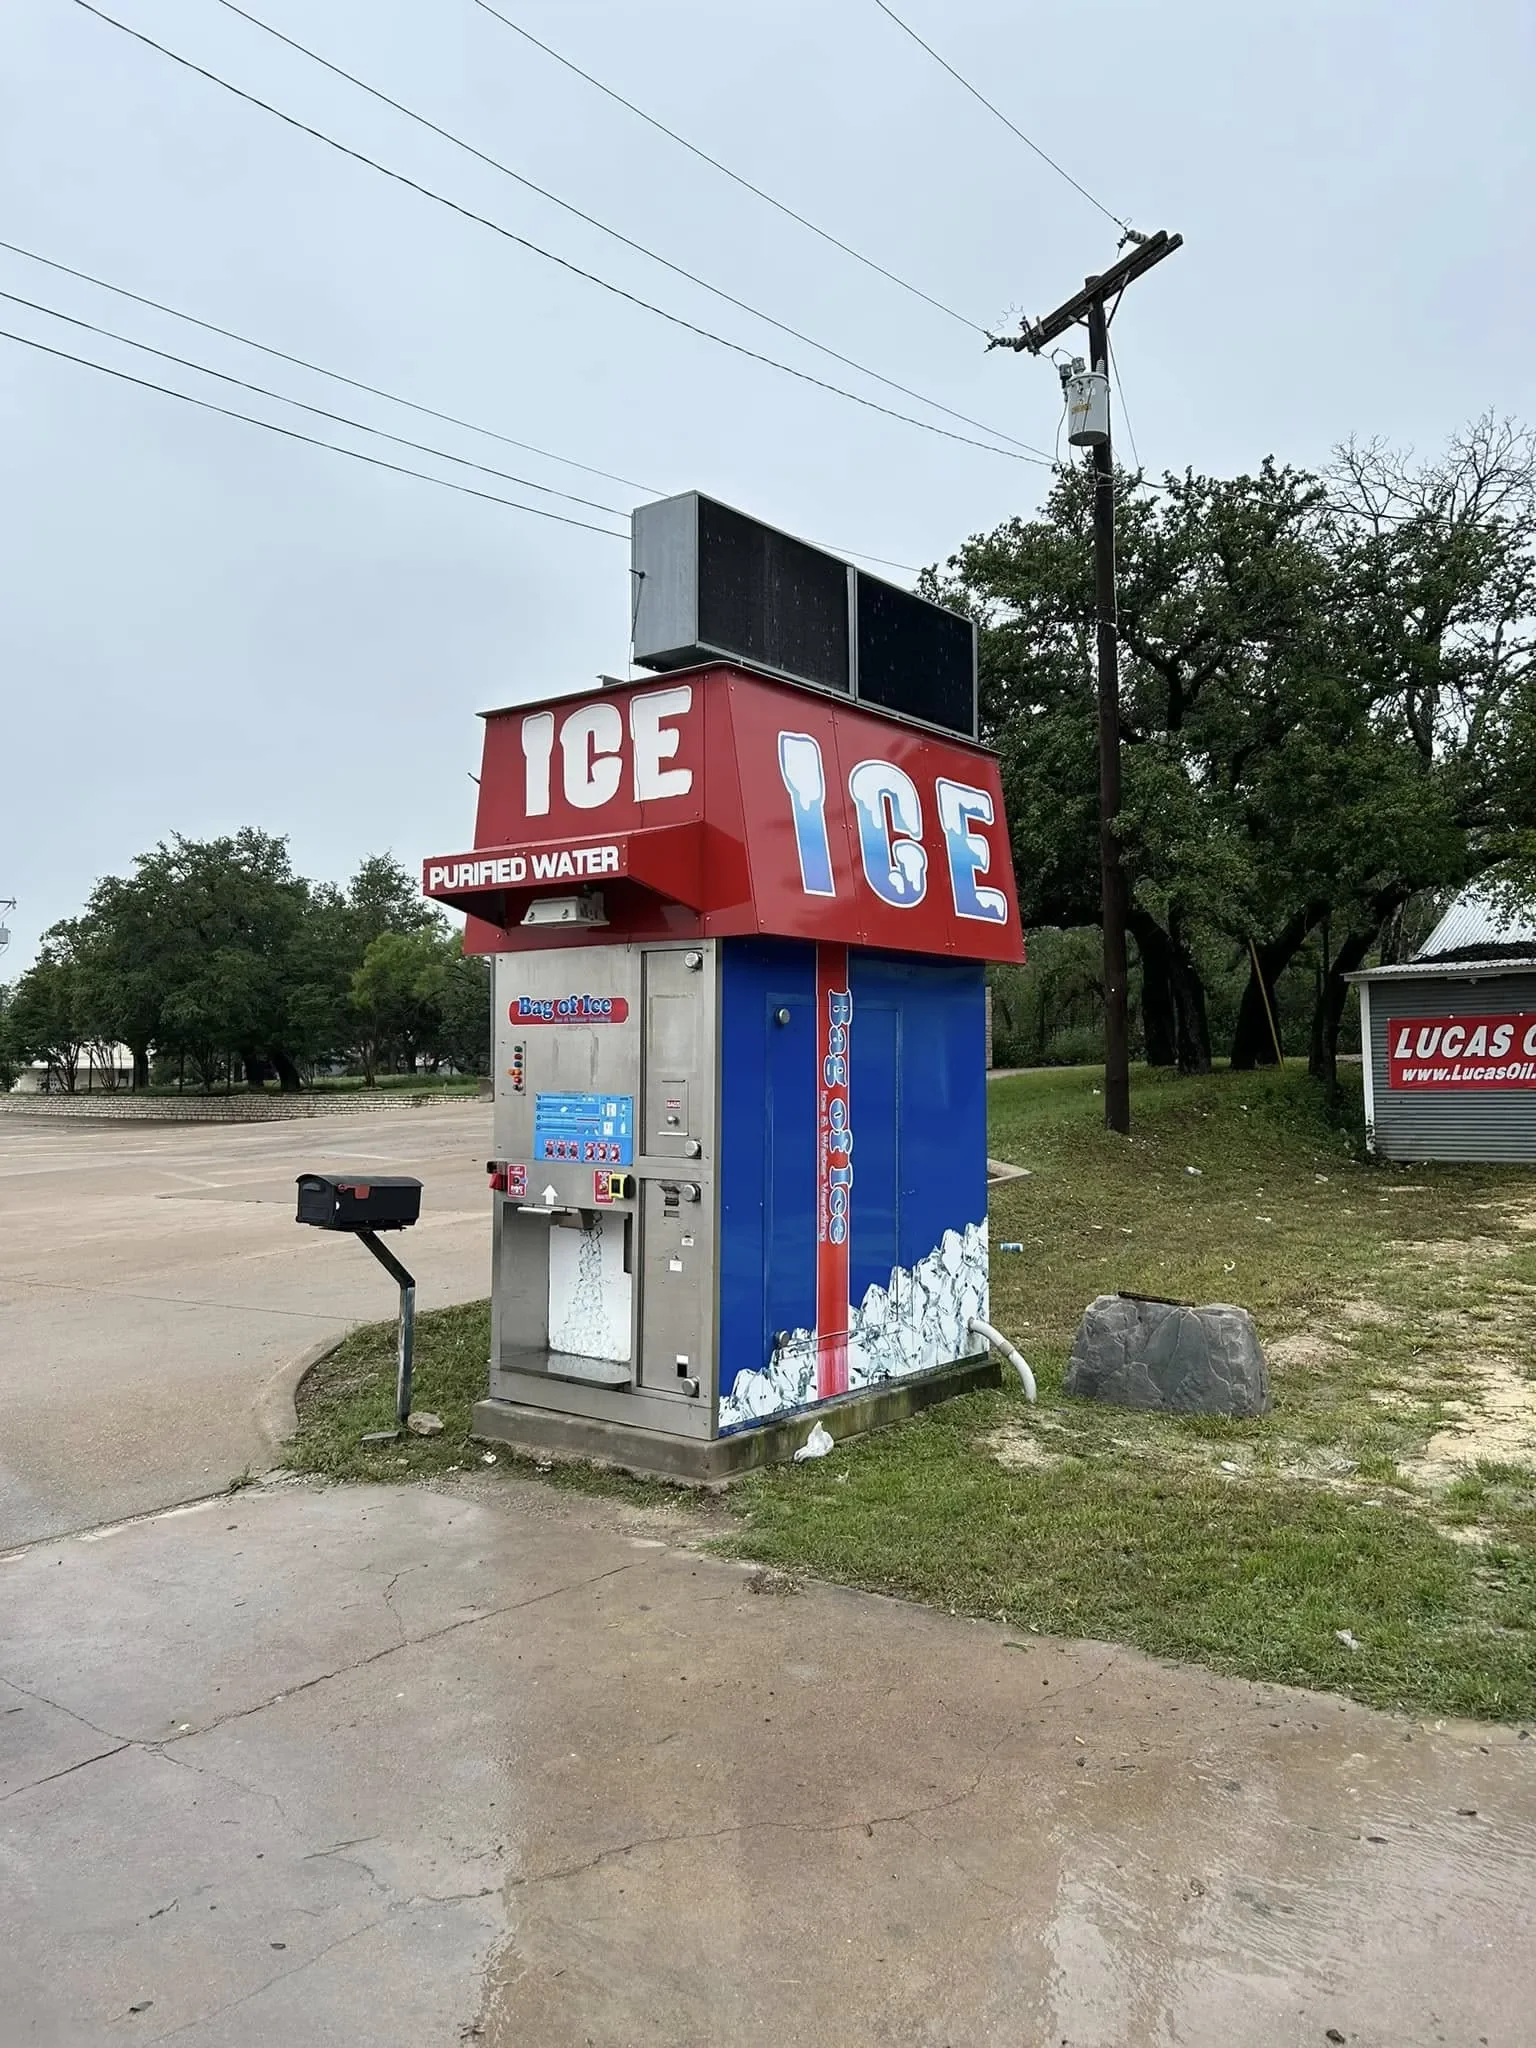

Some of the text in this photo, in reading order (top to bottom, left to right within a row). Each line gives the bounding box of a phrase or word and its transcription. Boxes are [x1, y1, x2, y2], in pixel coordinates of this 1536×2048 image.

[521, 685, 693, 817] ICE
[429, 846, 620, 890] PURIFIED WATER
[777, 731, 1008, 925] ICE
[518, 994, 612, 1020] Bag of Ice
[1393, 1023, 1515, 1060] LUCAS
[824, 988, 853, 1244] Bag of Ice
